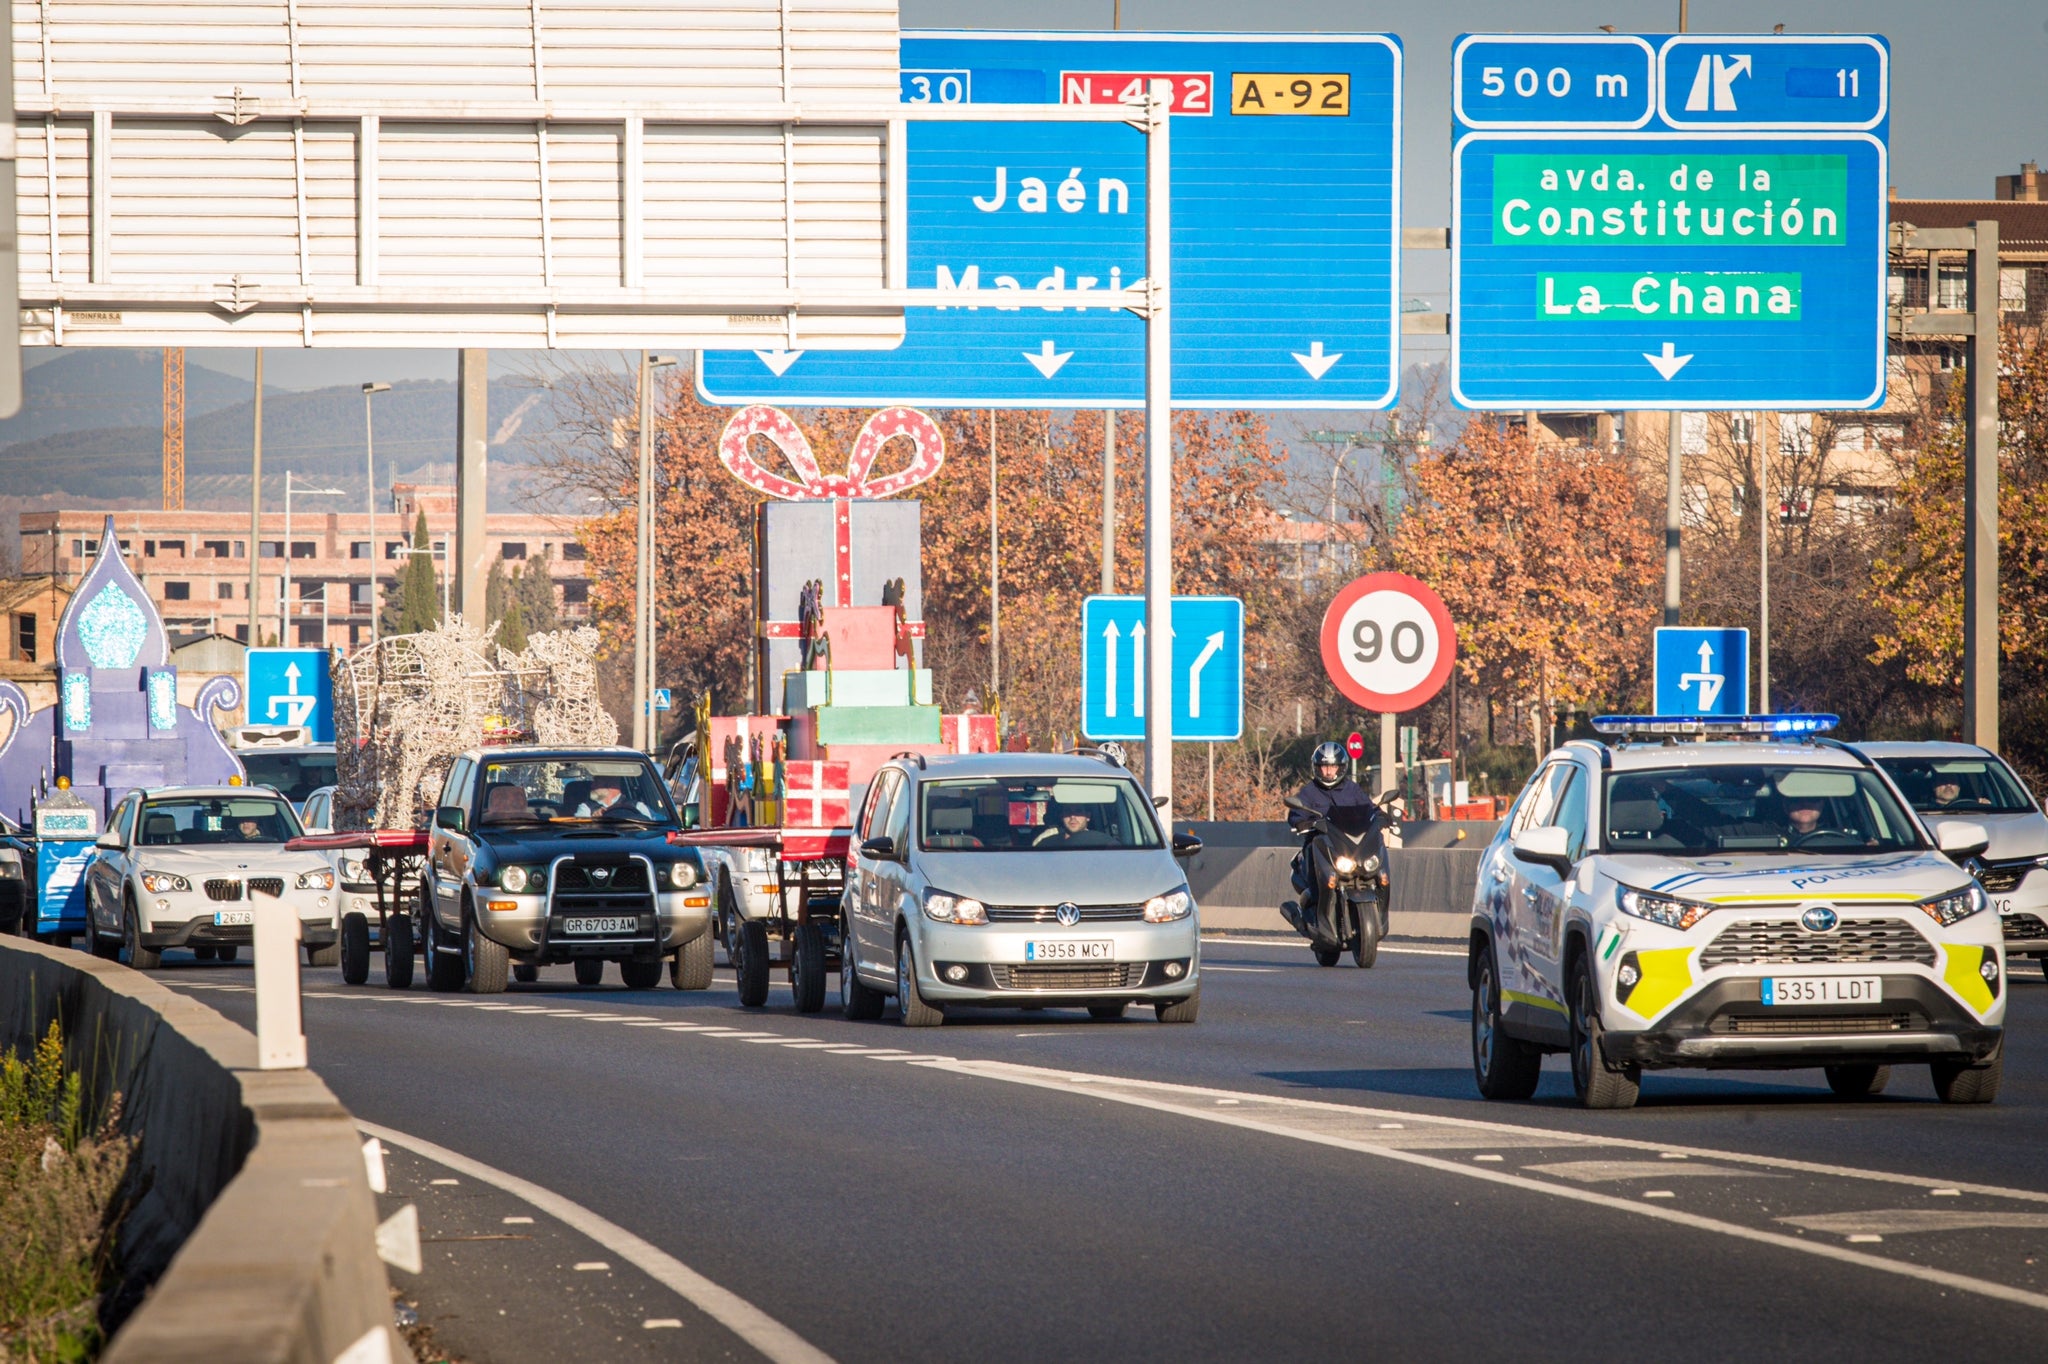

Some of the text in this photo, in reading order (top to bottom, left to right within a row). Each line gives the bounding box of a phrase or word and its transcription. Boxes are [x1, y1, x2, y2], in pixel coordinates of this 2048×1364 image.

[900, 76, 963, 103] 30
[1065, 78, 1207, 109] N-42
[1239, 80, 1343, 109] A-92
[1482, 67, 1628, 97] 500 m
[1836, 69, 1859, 97] 11
[972, 166, 1129, 214] Jaén
[1540, 164, 1771, 191] avda. de la
[1502, 198, 1837, 236] Constitución
[936, 264, 1146, 312] Madri
[1544, 276, 1792, 315] La Chana
[1352, 619, 1424, 664] 90
[1791, 868, 1882, 890] POLICIA
[223, 912, 251, 923] 2678
[1038, 943, 1109, 958] 3958 MCY
[1778, 980, 1874, 1000] 5351 LDT
